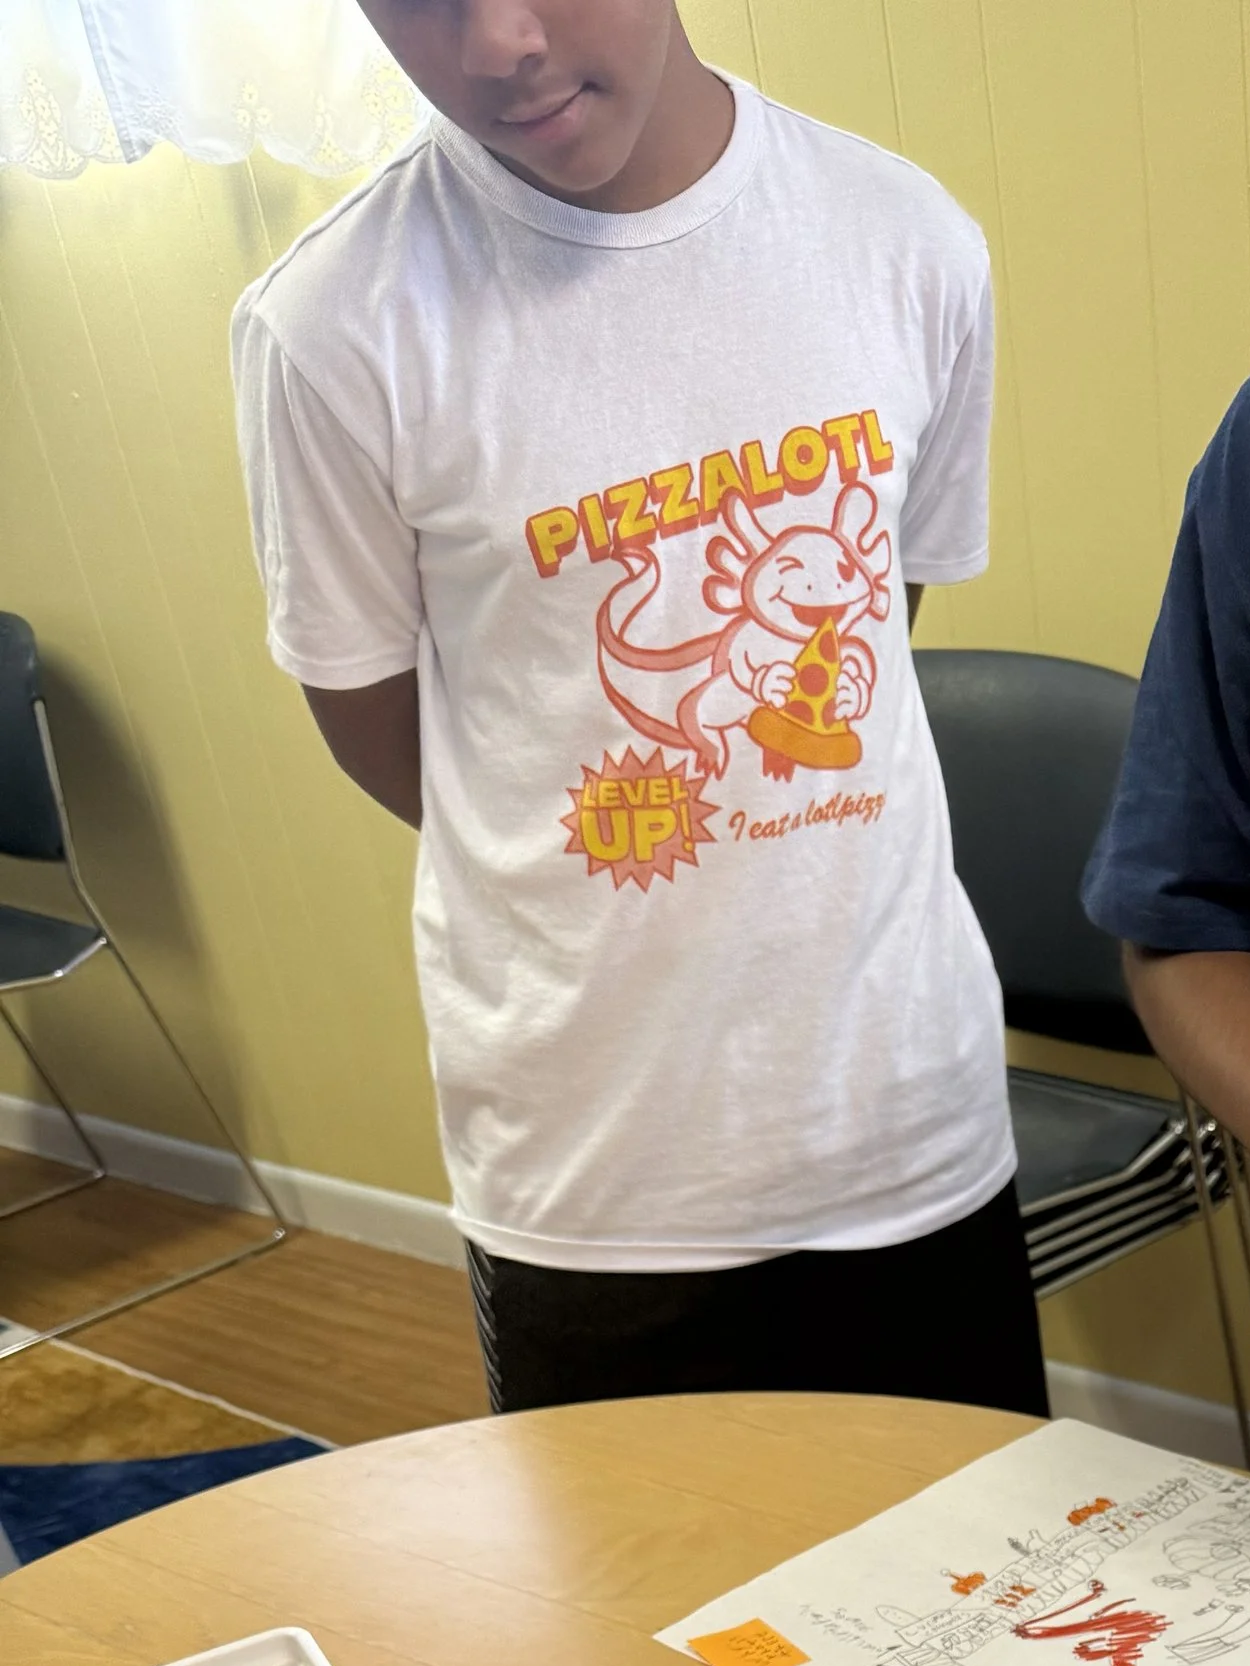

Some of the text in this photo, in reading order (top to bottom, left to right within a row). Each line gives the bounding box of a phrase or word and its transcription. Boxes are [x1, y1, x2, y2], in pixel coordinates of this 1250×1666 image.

[526, 410, 893, 579] PIZZALOTL
[581, 774, 688, 808] LEVEL
[579, 802, 696, 861] UP!
[728, 810, 746, 842] I
[748, 812, 790, 840] eat
